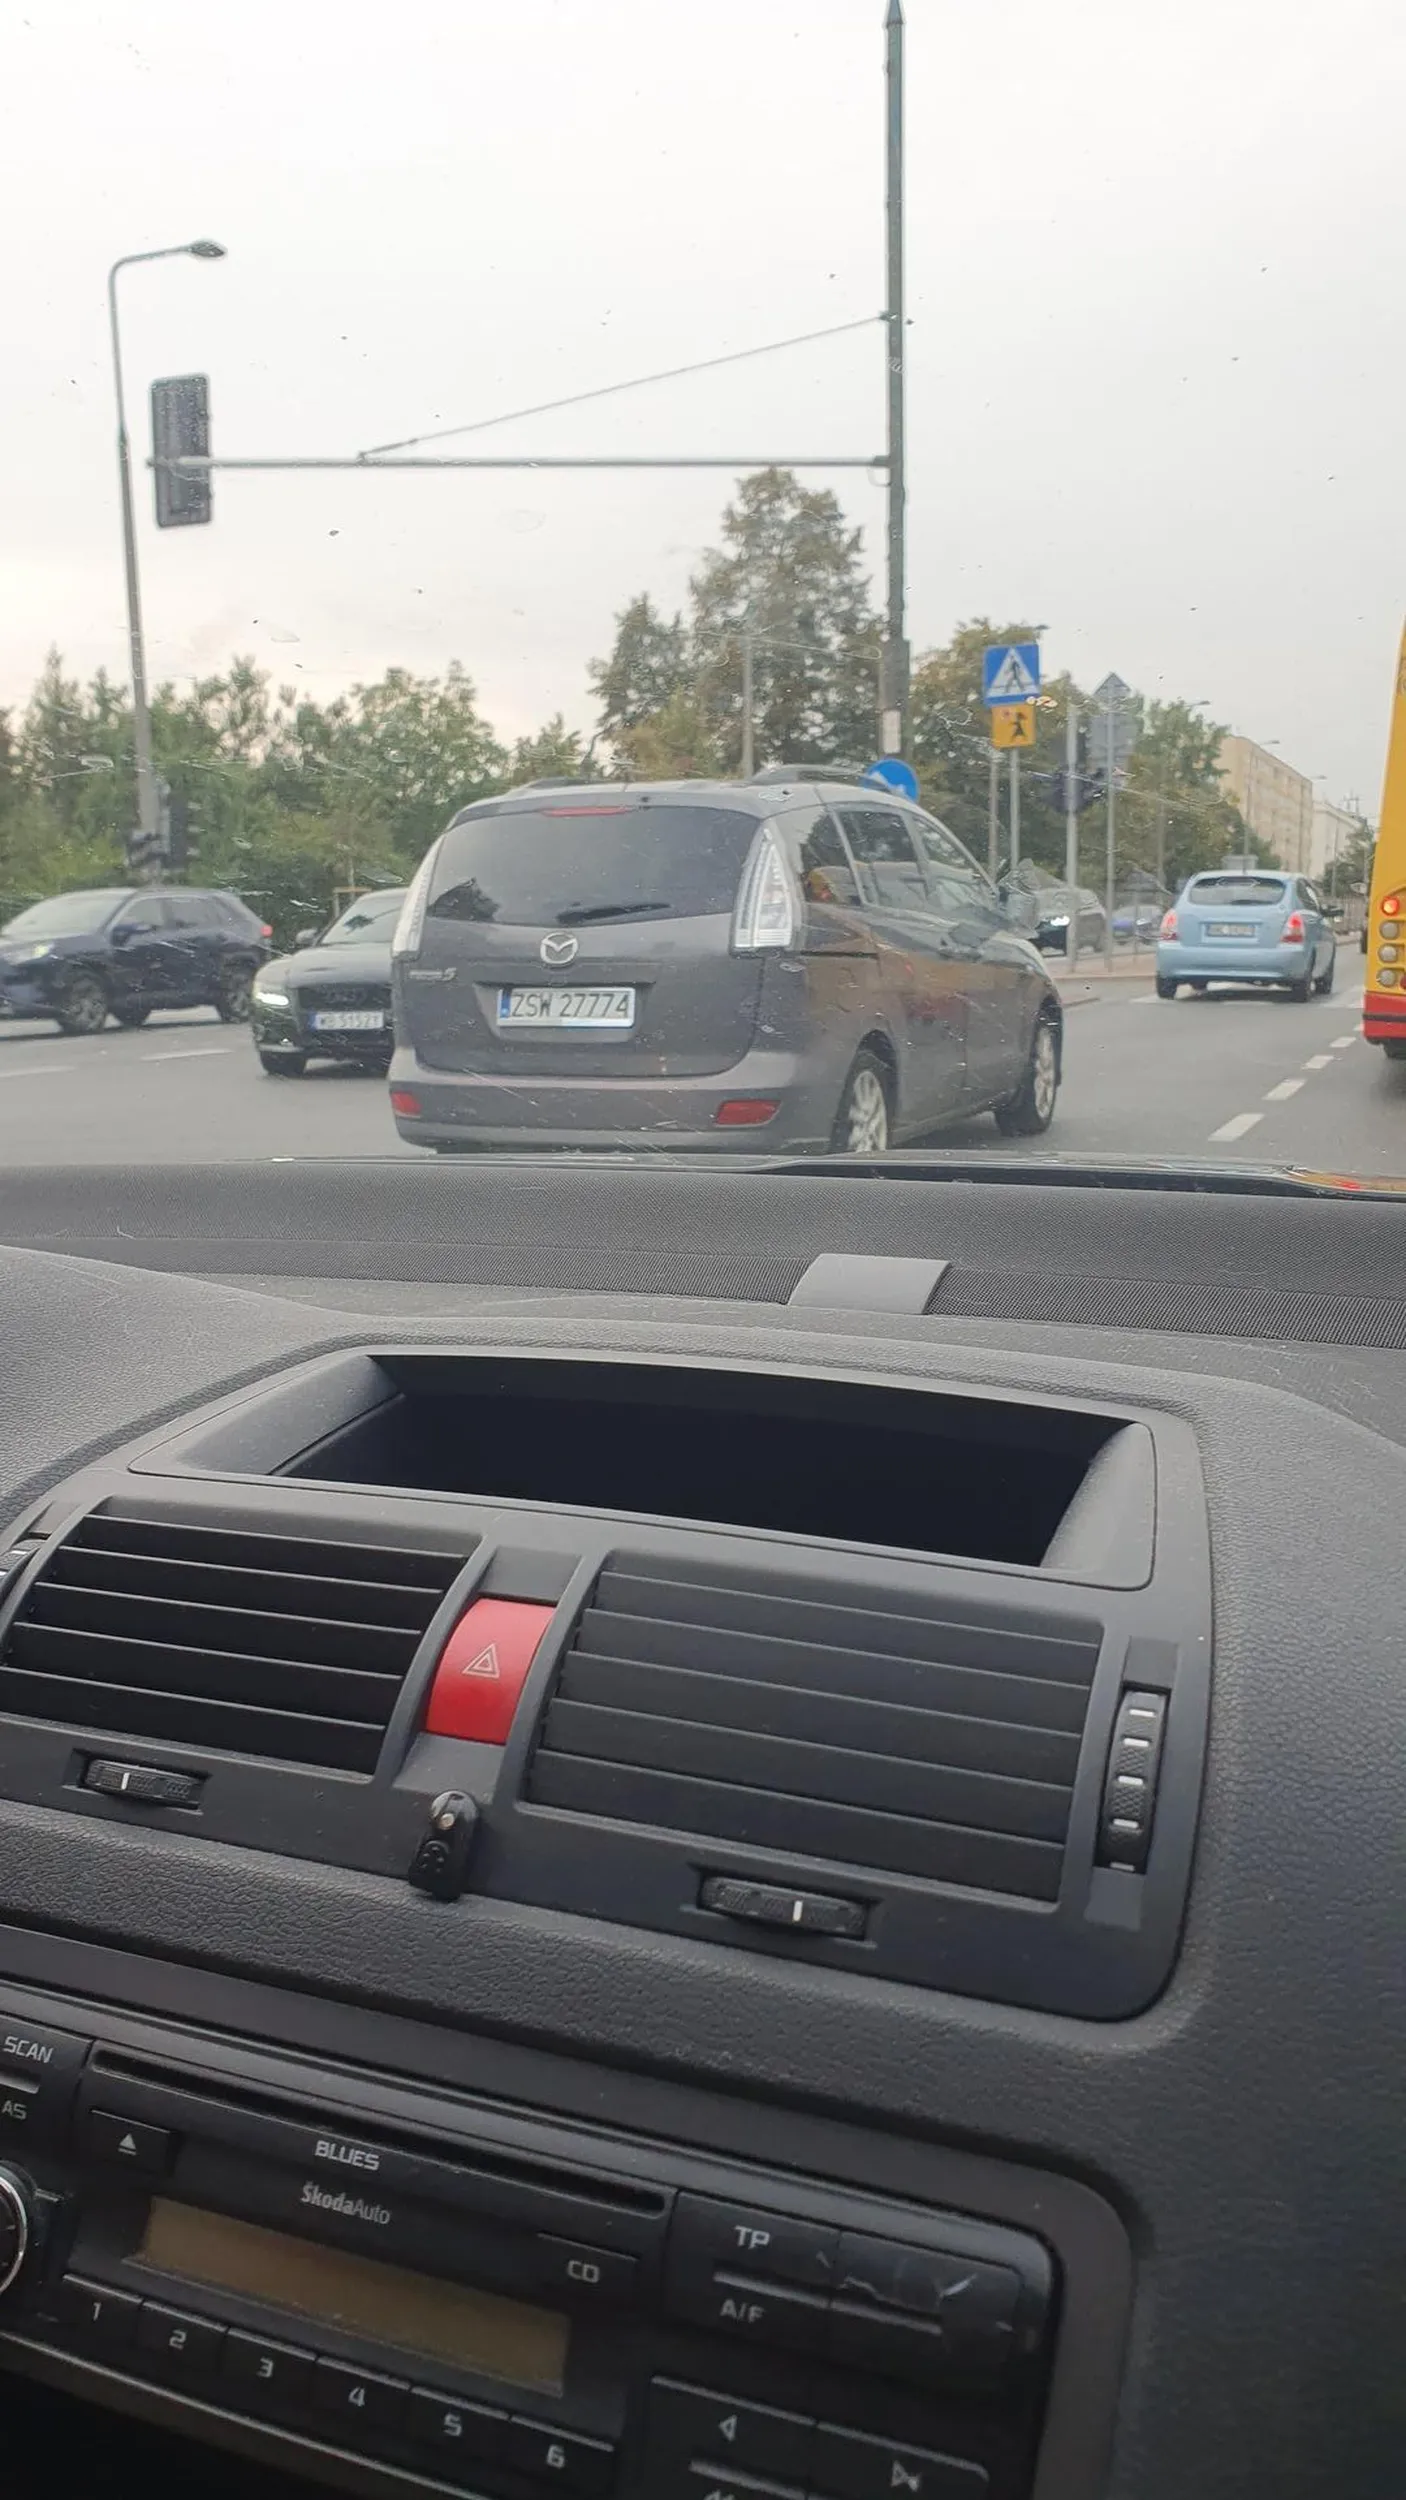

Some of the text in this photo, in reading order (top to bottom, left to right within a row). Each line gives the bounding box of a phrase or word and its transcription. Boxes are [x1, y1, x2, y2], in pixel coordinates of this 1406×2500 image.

[511, 992, 629, 1019] ZSW 27774
[3, 2035, 54, 2064] SCAN
[2, 2100, 27, 2120] AS
[315, 2139, 381, 2171] BLUES
[735, 2225, 770, 2248] TP
[567, 2259, 600, 2283] CD
[92, 2303, 101, 2321] 1
[720, 2299, 764, 2322] A/F
[169, 2330, 187, 2349] 2
[259, 2358, 274, 2378] 3
[348, 2387, 365, 2407] 4
[444, 2414, 462, 2436] 5
[546, 2445, 565, 2468] 6
